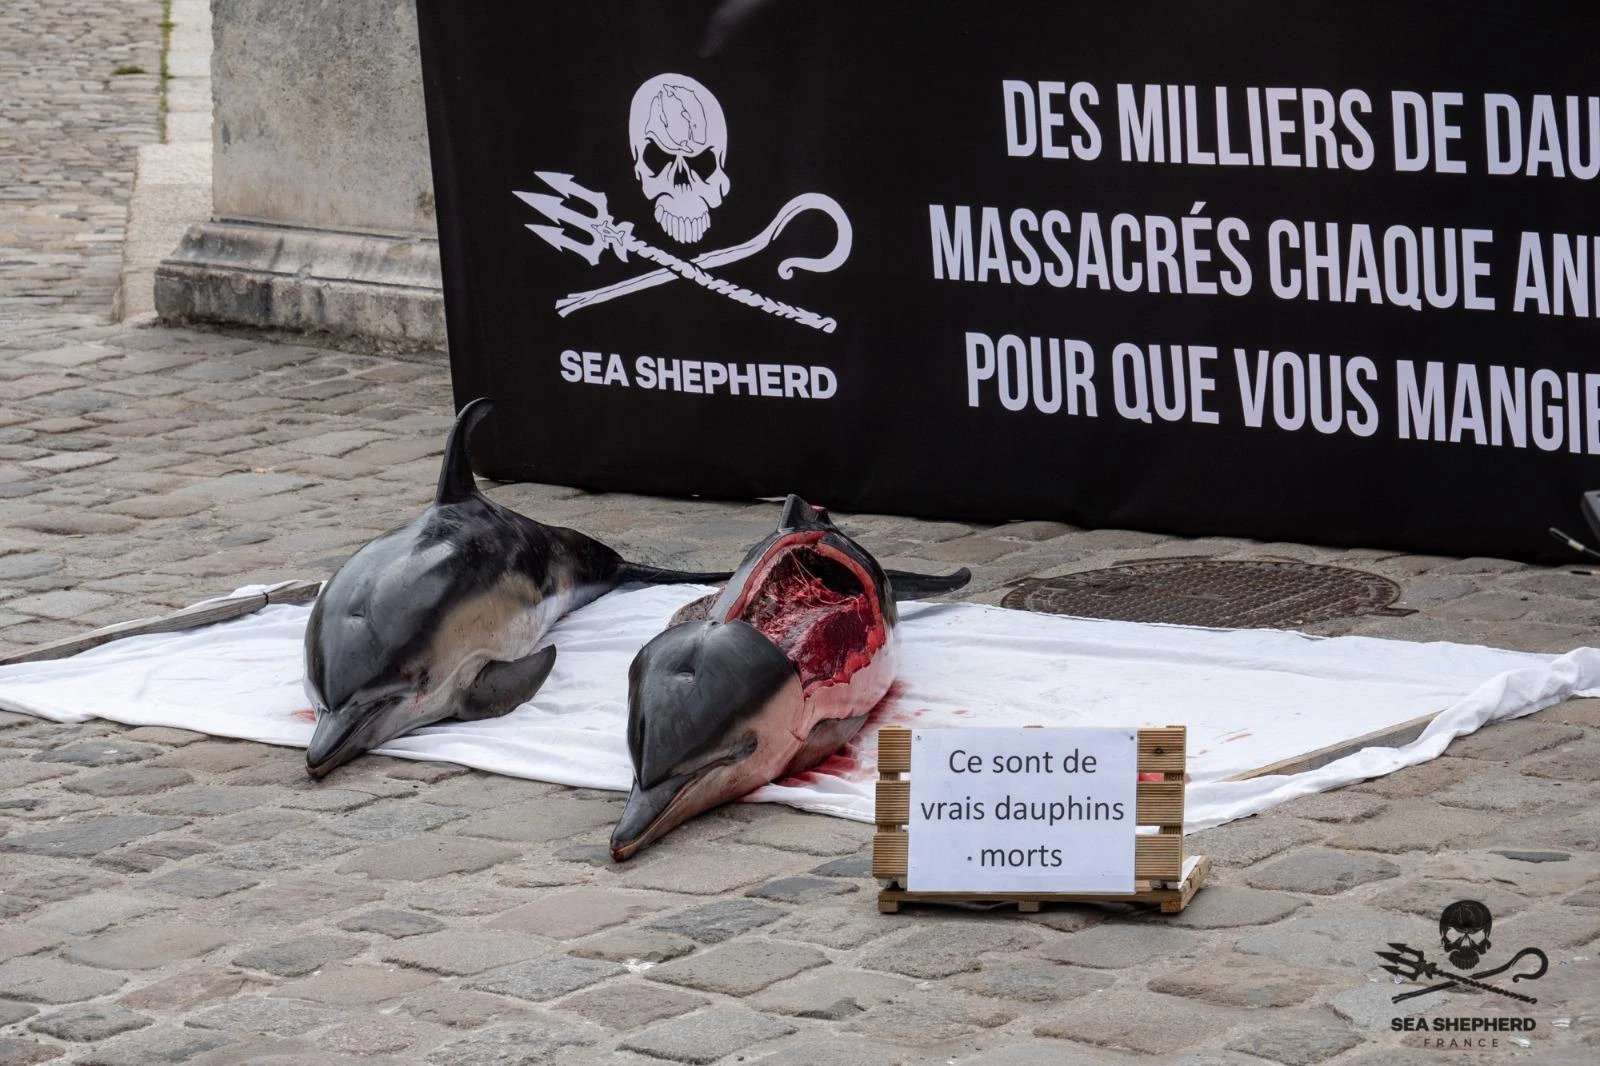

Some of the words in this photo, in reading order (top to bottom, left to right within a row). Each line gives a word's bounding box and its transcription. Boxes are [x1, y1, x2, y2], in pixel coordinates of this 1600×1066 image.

[1003, 80, 1102, 161] DES
[1117, 84, 1374, 171] MILLIERS
[1391, 90, 1466, 174] DE
[1484, 93, 1600, 180] DAU
[929, 201, 1252, 297] MASSACRÉS
[1268, 219, 1495, 311] CHAQUE
[1513, 231, 1600, 318] AN
[560, 350, 629, 387] SEA
[635, 355, 838, 399] SHEPHERD
[965, 332, 1098, 417] POUR
[1112, 343, 1219, 424] QUE
[1234, 349, 1379, 437] VOUS
[949, 750, 983, 774] Ce
[992, 751, 1053, 774] sont
[1063, 749, 1097, 774] de
[920, 797, 985, 820] vrais
[995, 795, 1124, 826] dauphins
[981, 845, 1063, 867] morts
